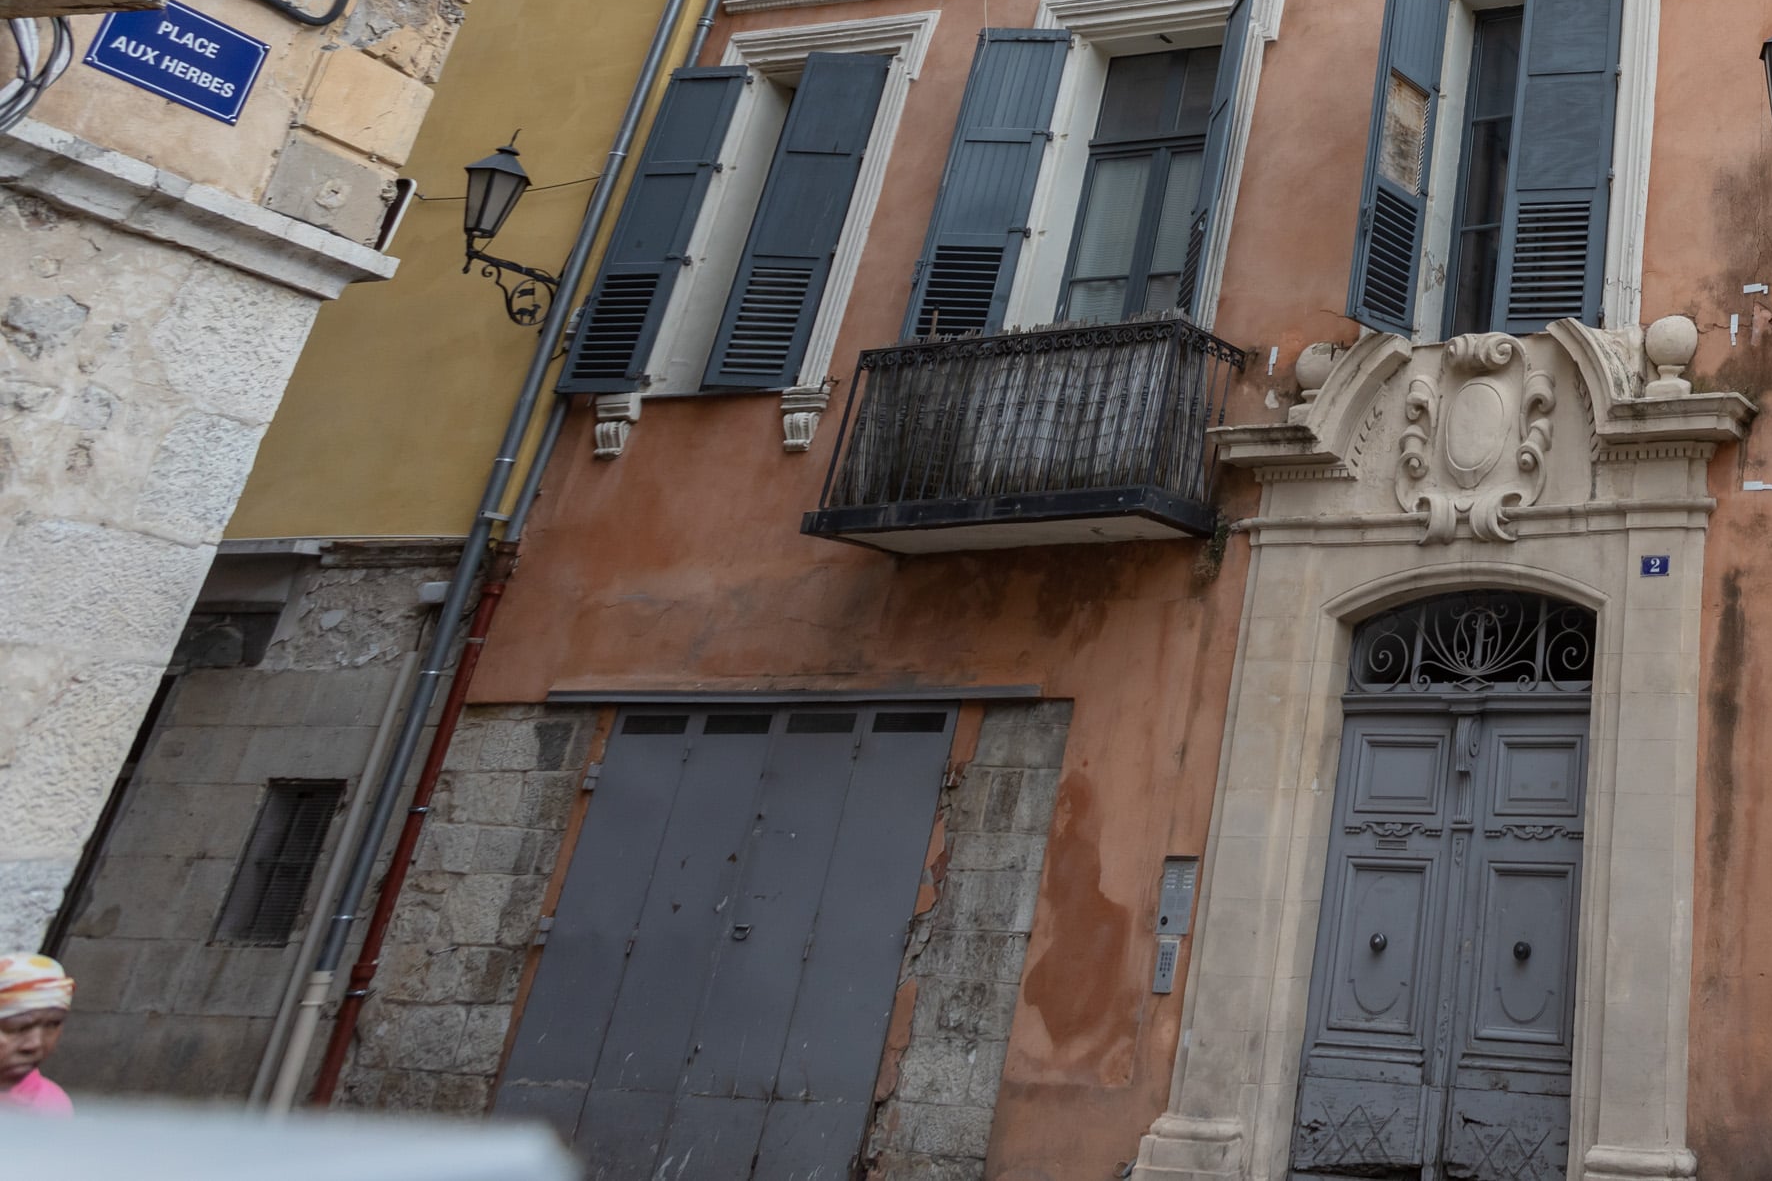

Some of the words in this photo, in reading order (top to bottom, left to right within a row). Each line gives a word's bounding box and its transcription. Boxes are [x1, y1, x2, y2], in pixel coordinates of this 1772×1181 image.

[156, 20, 221, 59] PLACE
[109, 35, 160, 65] AUX
[160, 55, 236, 98] HERBES
[1650, 557, 1660, 573] 2
